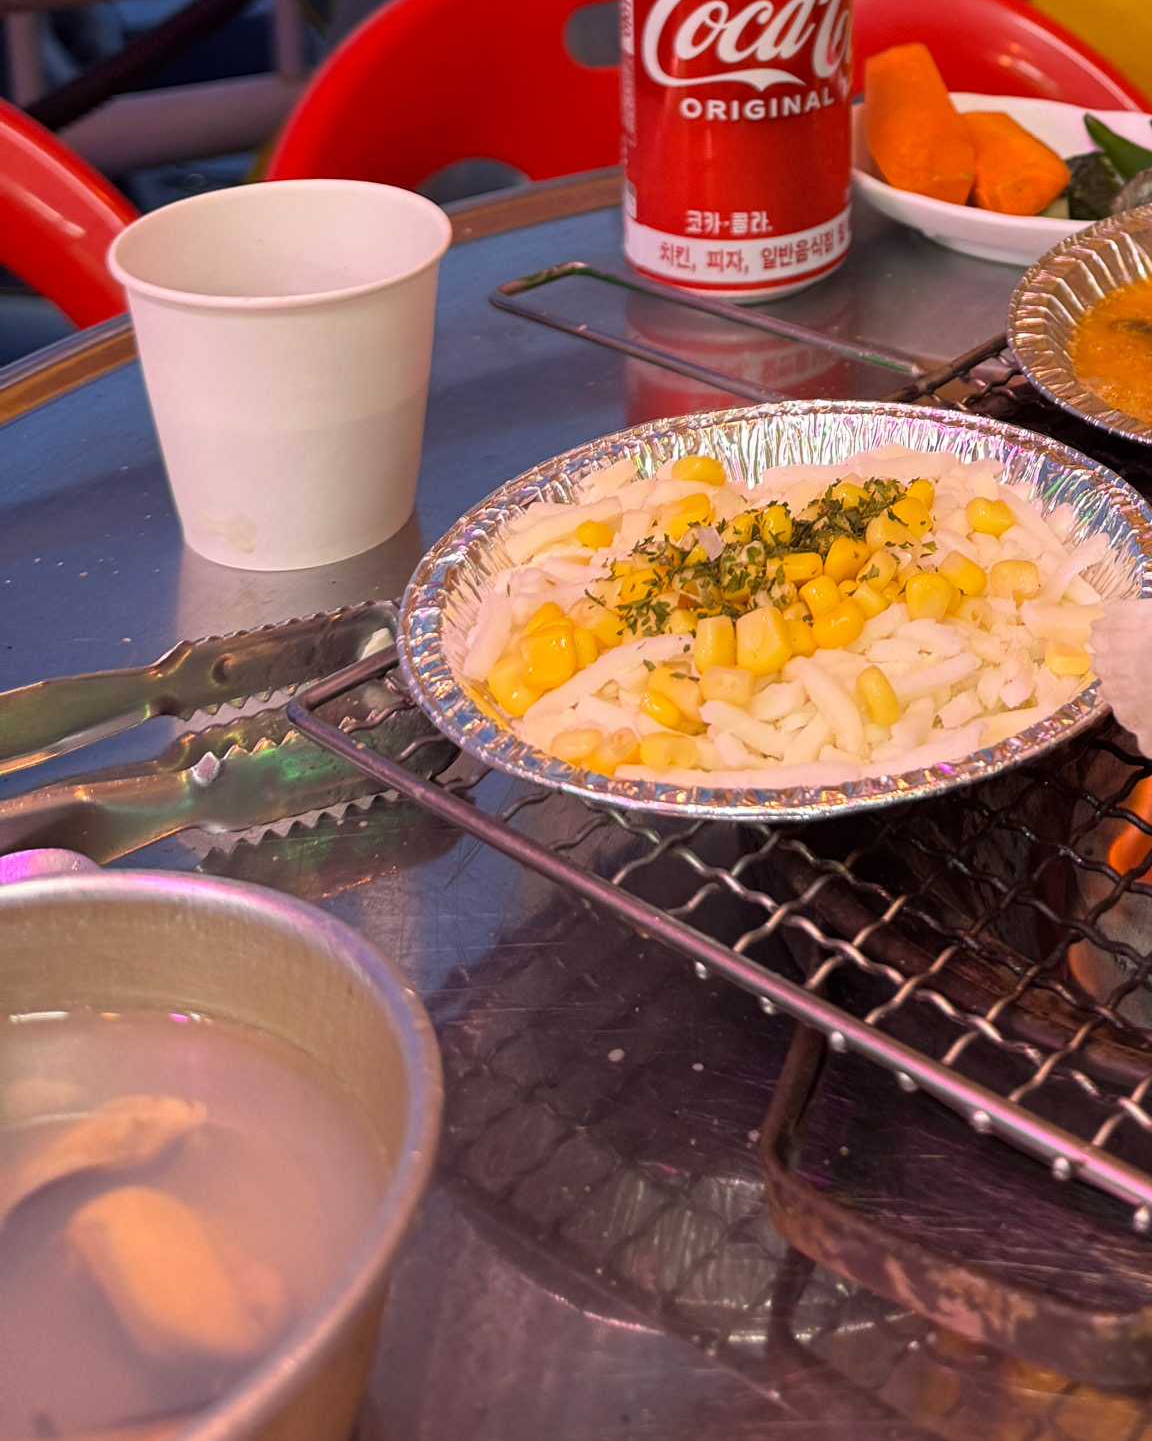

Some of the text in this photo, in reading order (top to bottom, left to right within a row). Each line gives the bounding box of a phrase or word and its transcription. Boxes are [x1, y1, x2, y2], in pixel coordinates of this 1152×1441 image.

[679, 86, 835, 121] ORIGINAL
[660, 242, 696, 272] 치킨,
[706, 250, 749, 274] 피자,
[761, 229, 835, 270] 일반음식점
